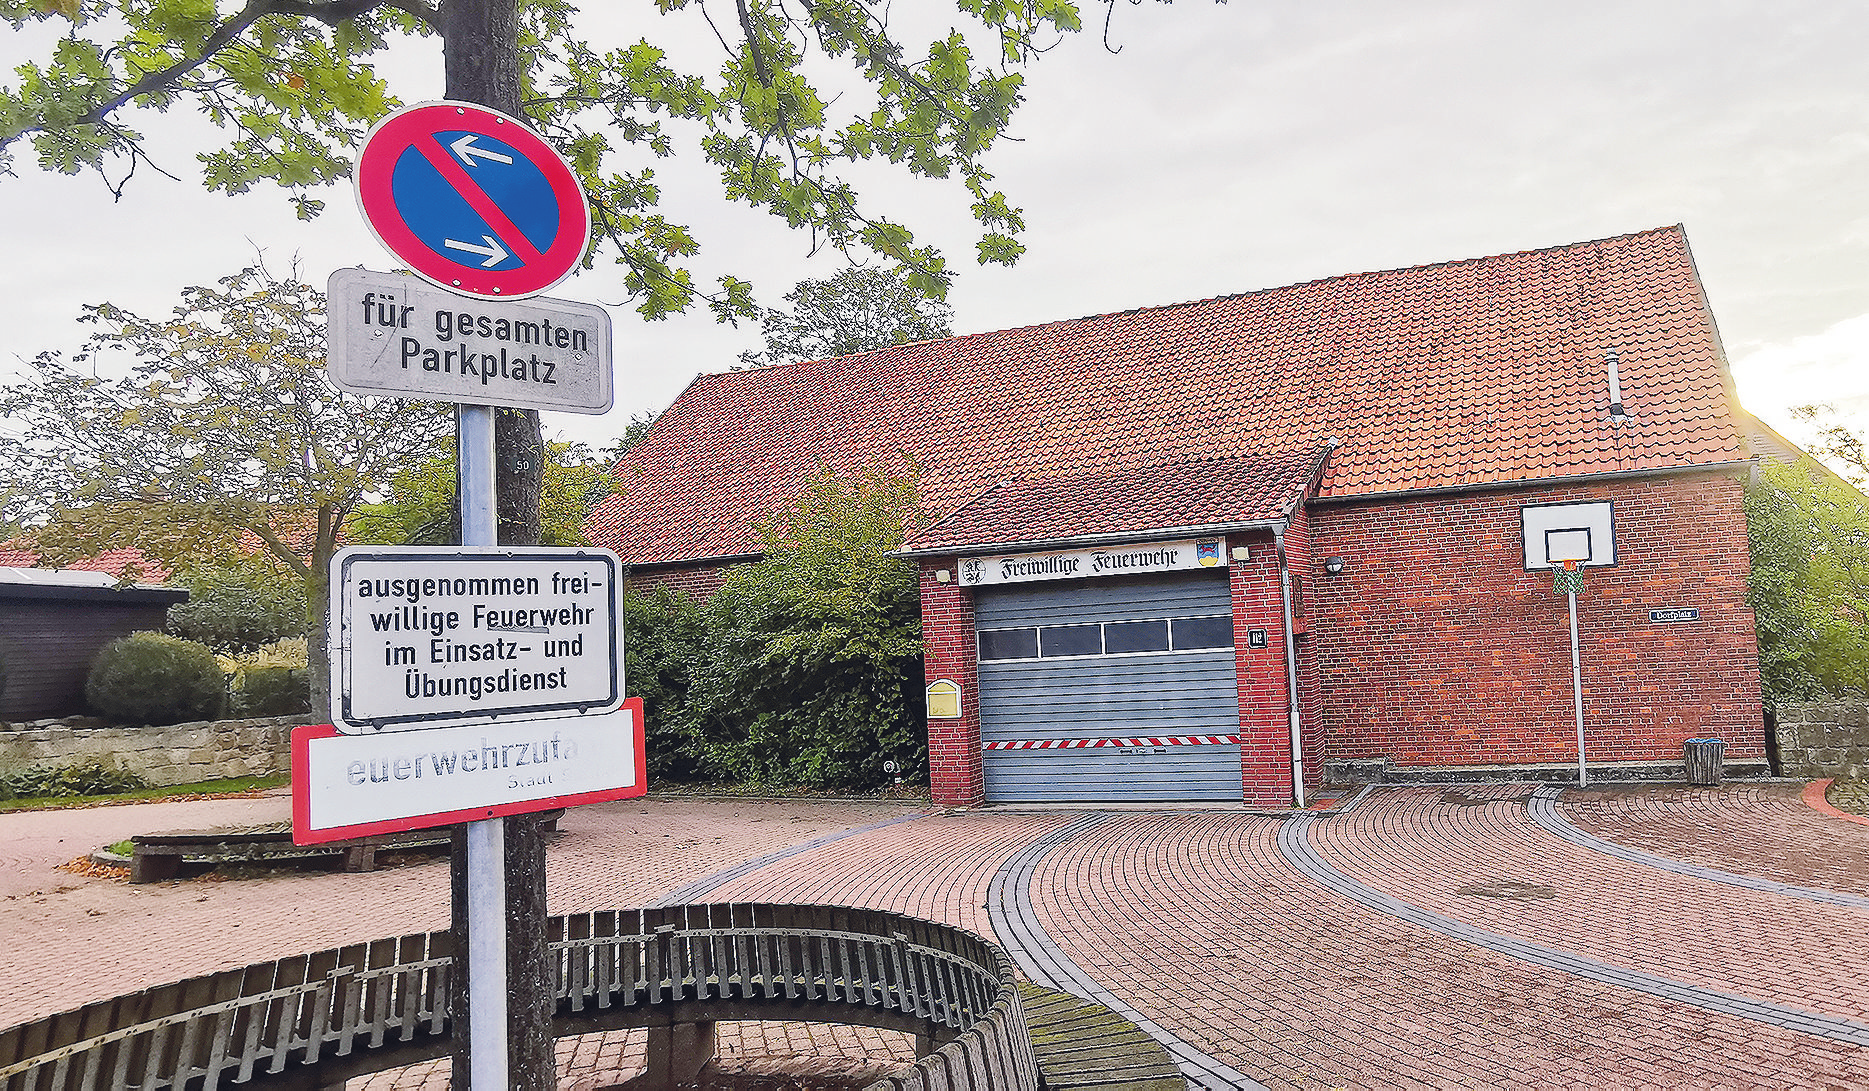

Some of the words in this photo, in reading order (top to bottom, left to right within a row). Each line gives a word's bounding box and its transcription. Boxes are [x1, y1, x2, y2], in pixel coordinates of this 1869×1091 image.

[361, 292, 414, 330] für
[435, 309, 588, 352] gesamten
[401, 336, 557, 385] Parkplatz
[999, 556, 1080, 580] Freiwillige
[1090, 546, 1178, 574] Feuerwehr
[358, 575, 540, 604] ausgenommen
[551, 571, 603, 595] frei-
[370, 606, 460, 637] willige
[473, 603, 595, 629] Feuerwehr
[385, 641, 417, 667] im
[431, 639, 531, 664] Einsatz-
[544, 634, 584, 659] und
[405, 667, 568, 701] Übungsdienst
